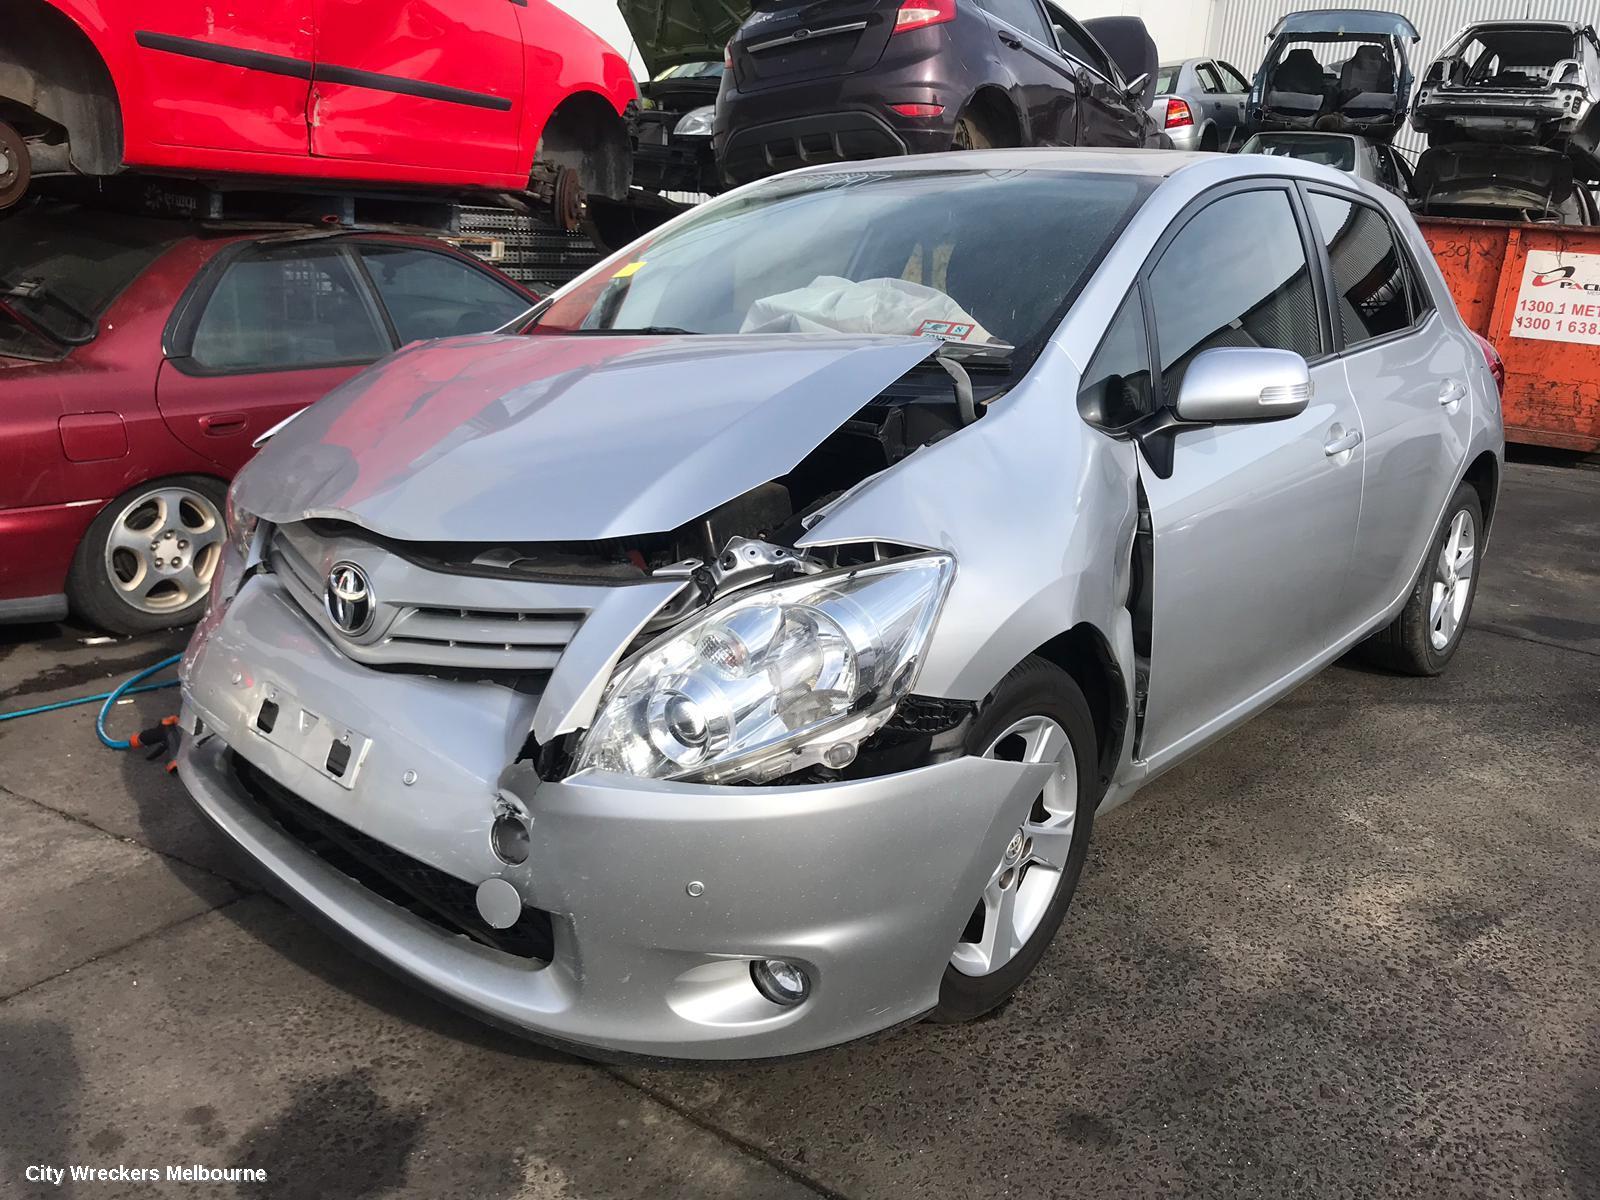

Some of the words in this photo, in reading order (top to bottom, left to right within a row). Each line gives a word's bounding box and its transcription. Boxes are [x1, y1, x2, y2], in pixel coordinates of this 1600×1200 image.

[1560, 281, 1600, 292] PACI
[1520, 299, 1554, 313] 1300
[1559, 302, 1566, 314] 1
[1516, 316, 1550, 330] 1300
[1556, 320, 1563, 331] 1
[1568, 321, 1600, 335] 638
